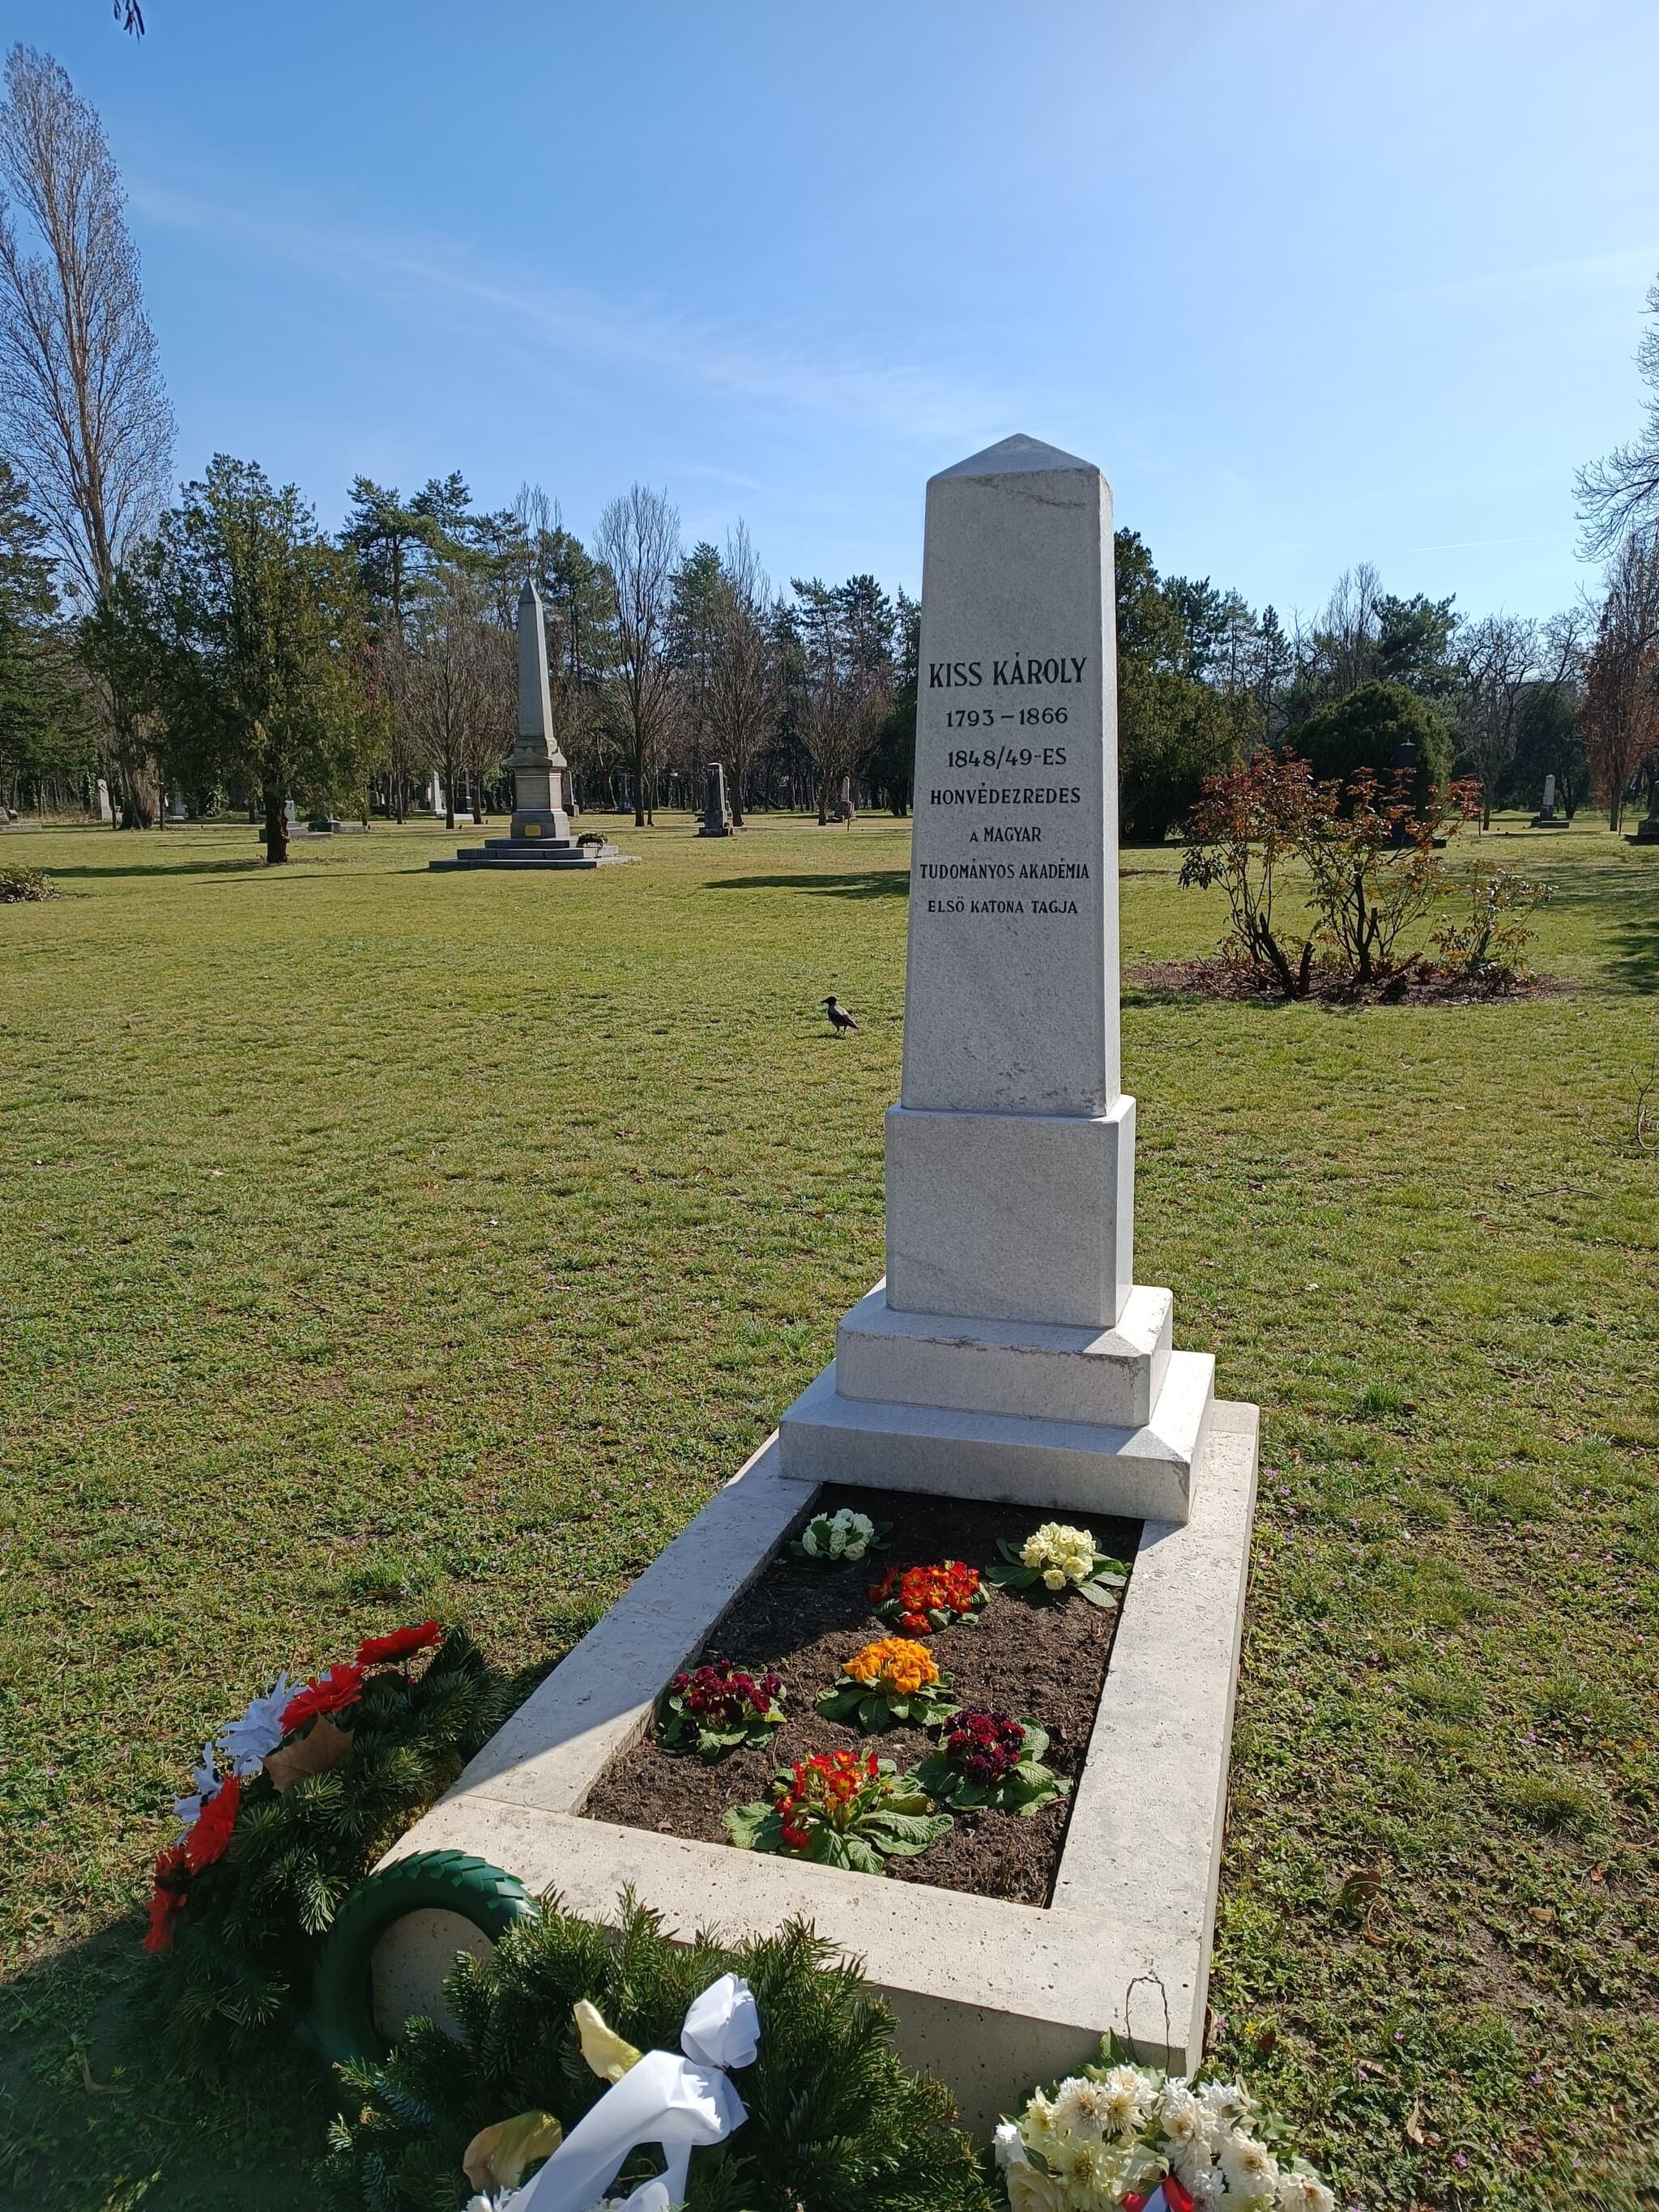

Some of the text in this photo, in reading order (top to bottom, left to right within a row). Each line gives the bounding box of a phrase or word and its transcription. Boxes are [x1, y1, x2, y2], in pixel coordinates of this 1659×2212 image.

[928, 651, 1087, 688] KISS KÁROLY
[948, 745, 1067, 770] 1848/49-ES
[930, 782, 1081, 805] HONVÉDEZREDES
[969, 825, 1042, 843] A MAGYAR
[919, 857, 1090, 880] TUDOMÁNYOS AKADÉMIA
[970, 900, 1025, 914] KATONA
[1030, 899, 1078, 914] TAGJA
